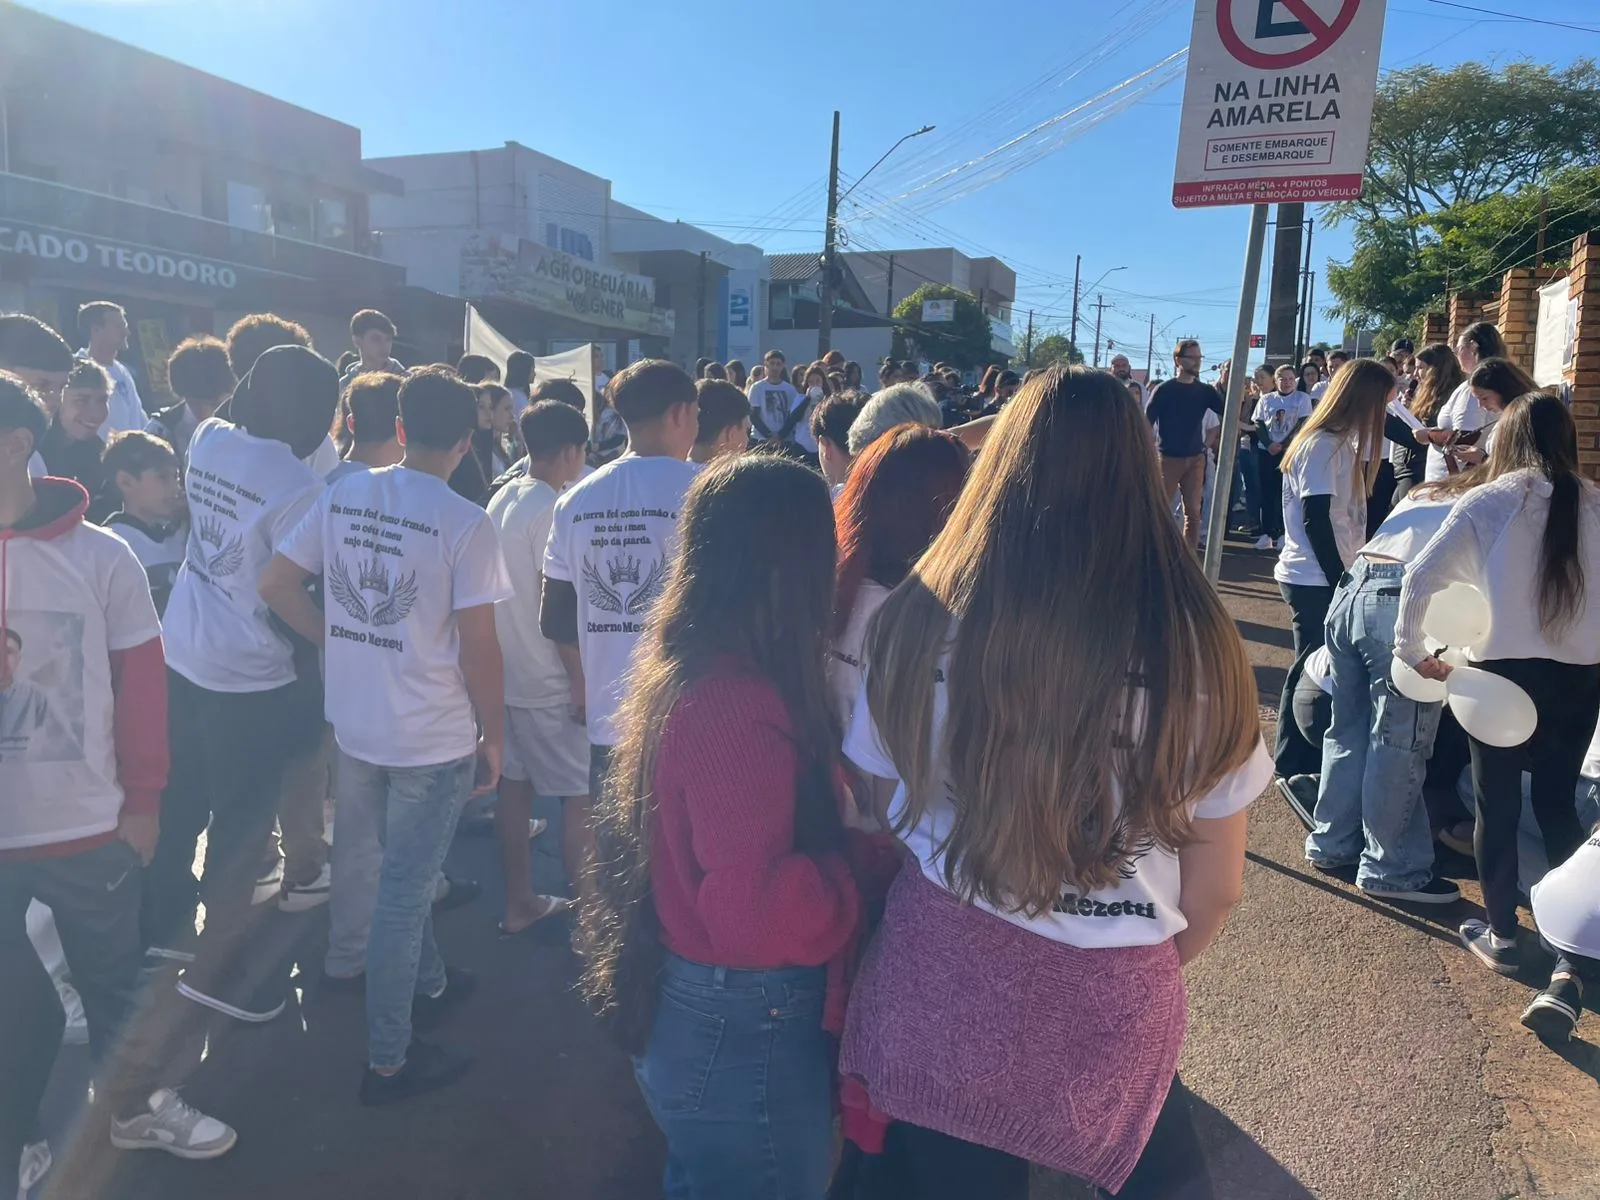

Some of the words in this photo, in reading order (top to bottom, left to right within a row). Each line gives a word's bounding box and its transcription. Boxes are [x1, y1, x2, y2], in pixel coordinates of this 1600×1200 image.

[1213, 80, 1250, 103] NA
[1258, 72, 1341, 99] LINHA
[1206, 99, 1341, 129] AMARELA
[1212, 140, 1262, 153] SOMENTE
[1265, 137, 1329, 150] EMBARQUE
[1221, 155, 1229, 164] E
[1231, 150, 1315, 163] DESEMBARQUE
[1173, 194, 1209, 204] SUJEITO
[1209, 193, 1216, 202] A
[1217, 192, 1245, 201] MULTA
[1246, 191, 1252, 199] E
[1254, 188, 1300, 201] REMOÇÃO
[1302, 188, 1316, 197] DO
[1317, 185, 1360, 197] VEÍCULO
[1202, 180, 1246, 193] INFRAÇÃO
[1283, 181, 1289, 189] 4
[1290, 178, 1329, 189] PONTOS
[95, 243, 238, 289] TEODORO
[535, 255, 649, 301] AGROPECUÁRIA
[1052, 892, 1157, 920] Mezetti
